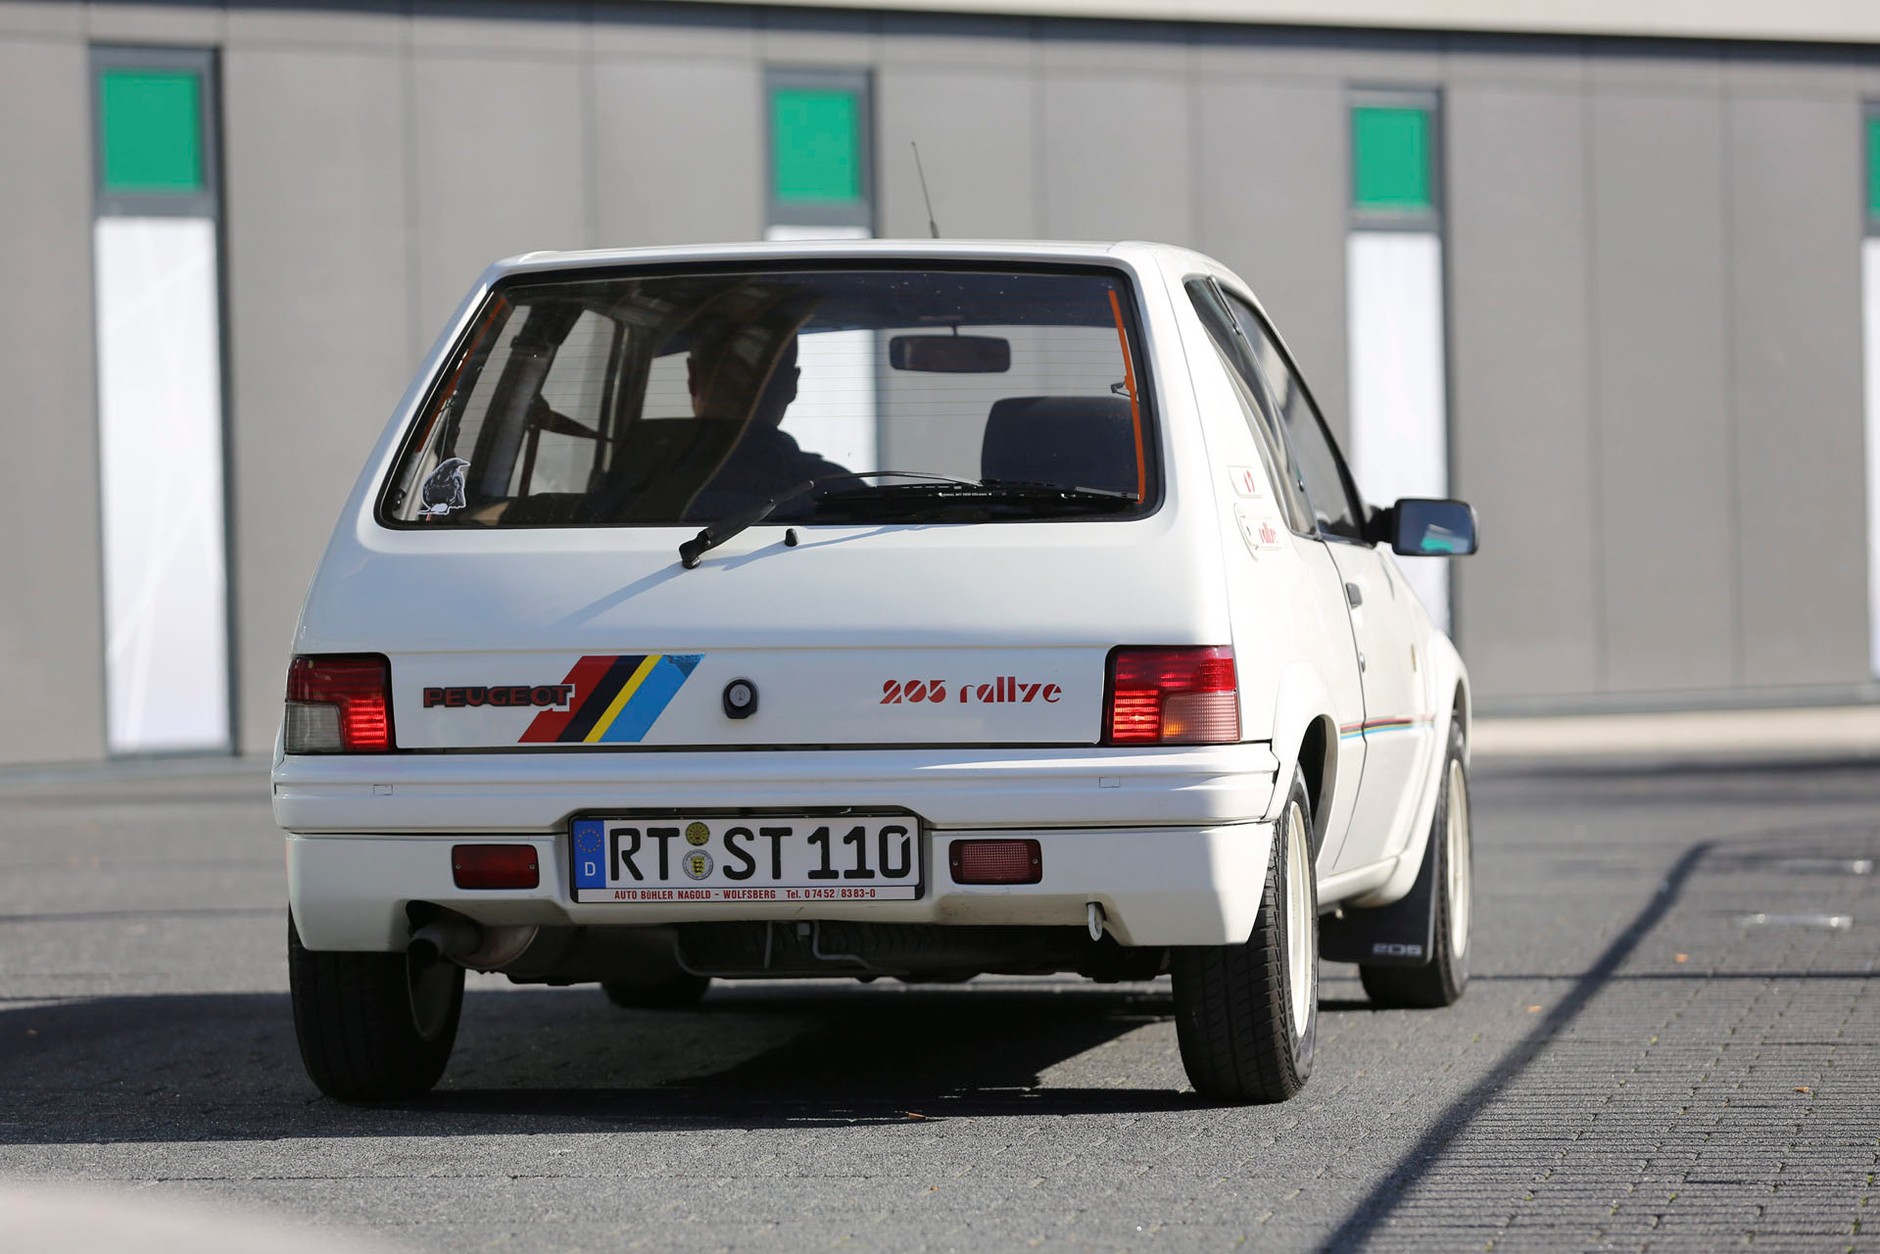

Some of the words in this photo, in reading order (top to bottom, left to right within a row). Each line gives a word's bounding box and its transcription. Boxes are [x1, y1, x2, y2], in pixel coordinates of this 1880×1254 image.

[423, 685, 573, 708] PEUGEOT
[879, 679, 947, 705] 205
[959, 676, 1062, 704] rallye
[609, 827, 680, 881] RT
[722, 826, 793, 881] ST
[807, 825, 911, 880] 110
[584, 861, 596, 877] D
[614, 890, 637, 900] AUTO
[640, 890, 673, 900] BÜHLER
[678, 889, 711, 900] NAGOLD
[723, 889, 776, 899] WOLFSBERG
[786, 889, 801, 899] Tel.
